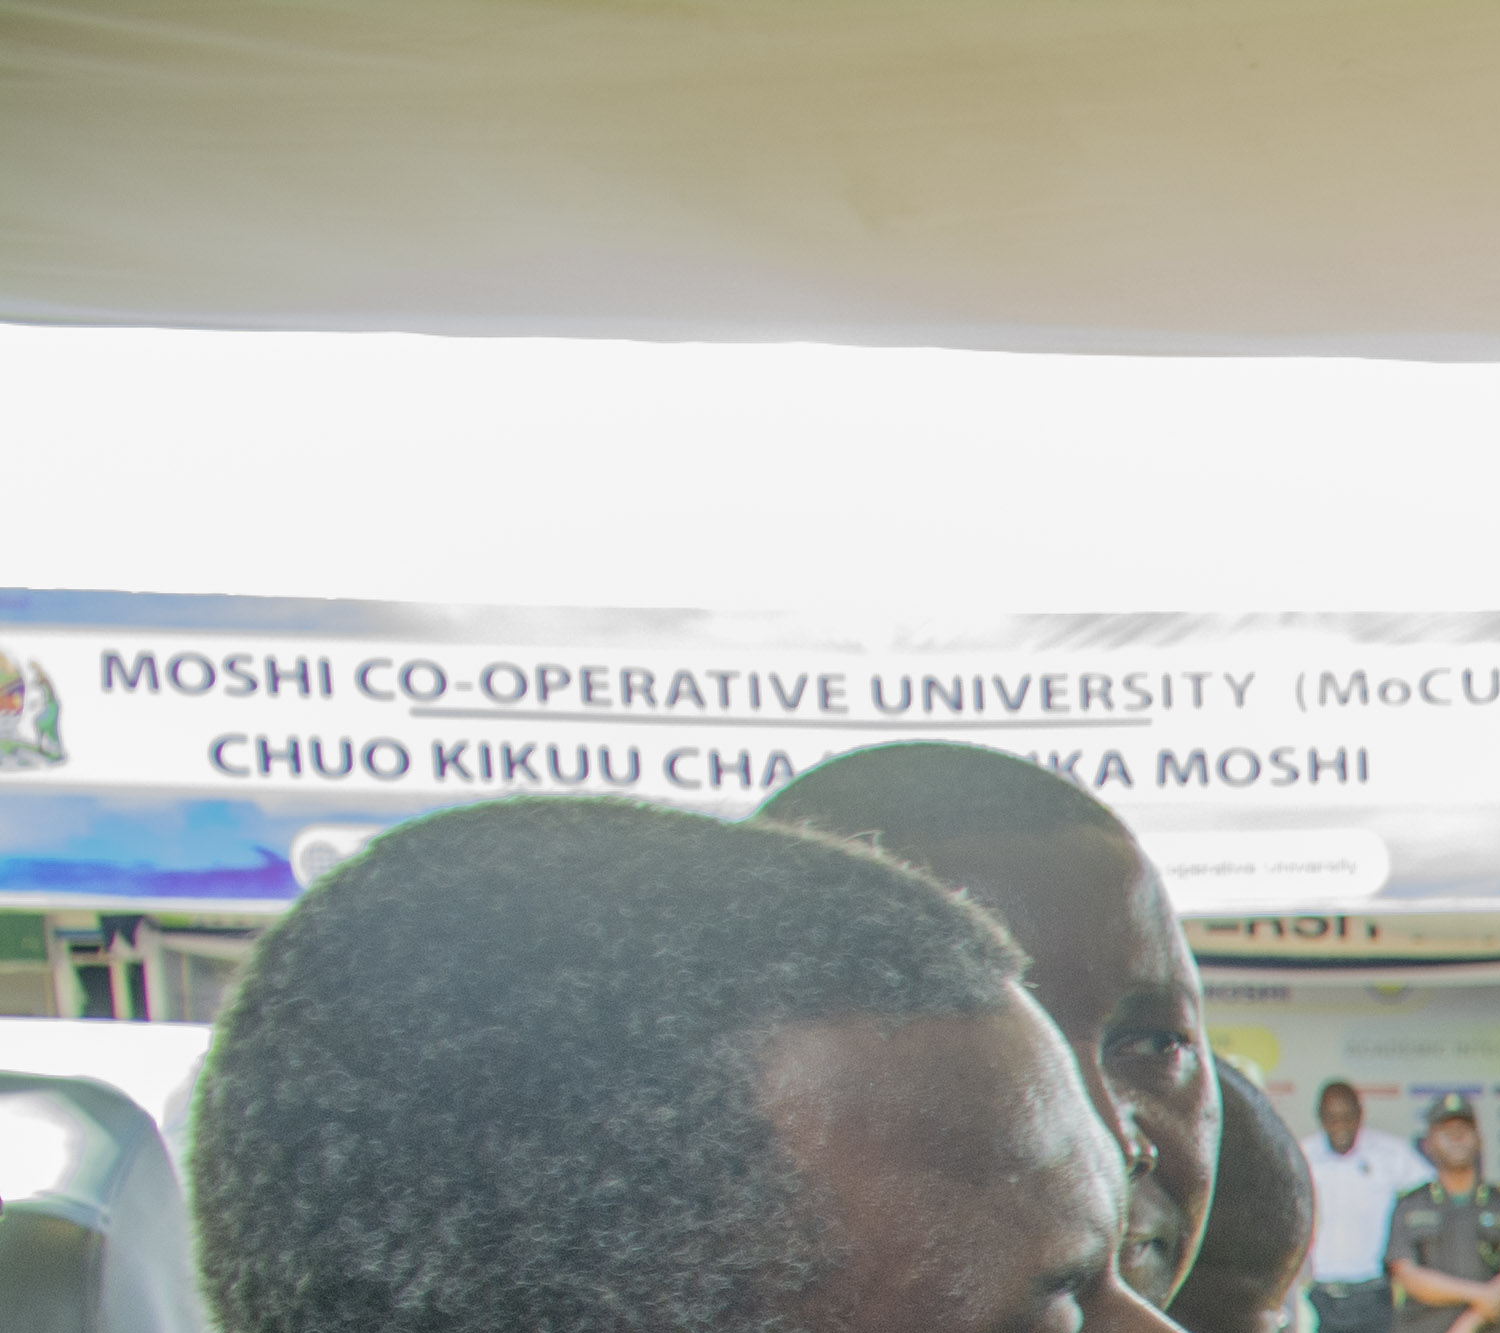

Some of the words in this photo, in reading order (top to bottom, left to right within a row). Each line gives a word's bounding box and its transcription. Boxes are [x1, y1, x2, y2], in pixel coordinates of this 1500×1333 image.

[100, 650, 333, 700] MOSHI
[354, 658, 849, 715] CO-OPERATIVE
[871, 671, 1257, 716] UNIVERSITY
[209, 733, 410, 781] CHUO
[432, 739, 642, 787] KIKUU
[663, 746, 797, 791] CHA
[1156, 746, 1368, 788] MOSHI
